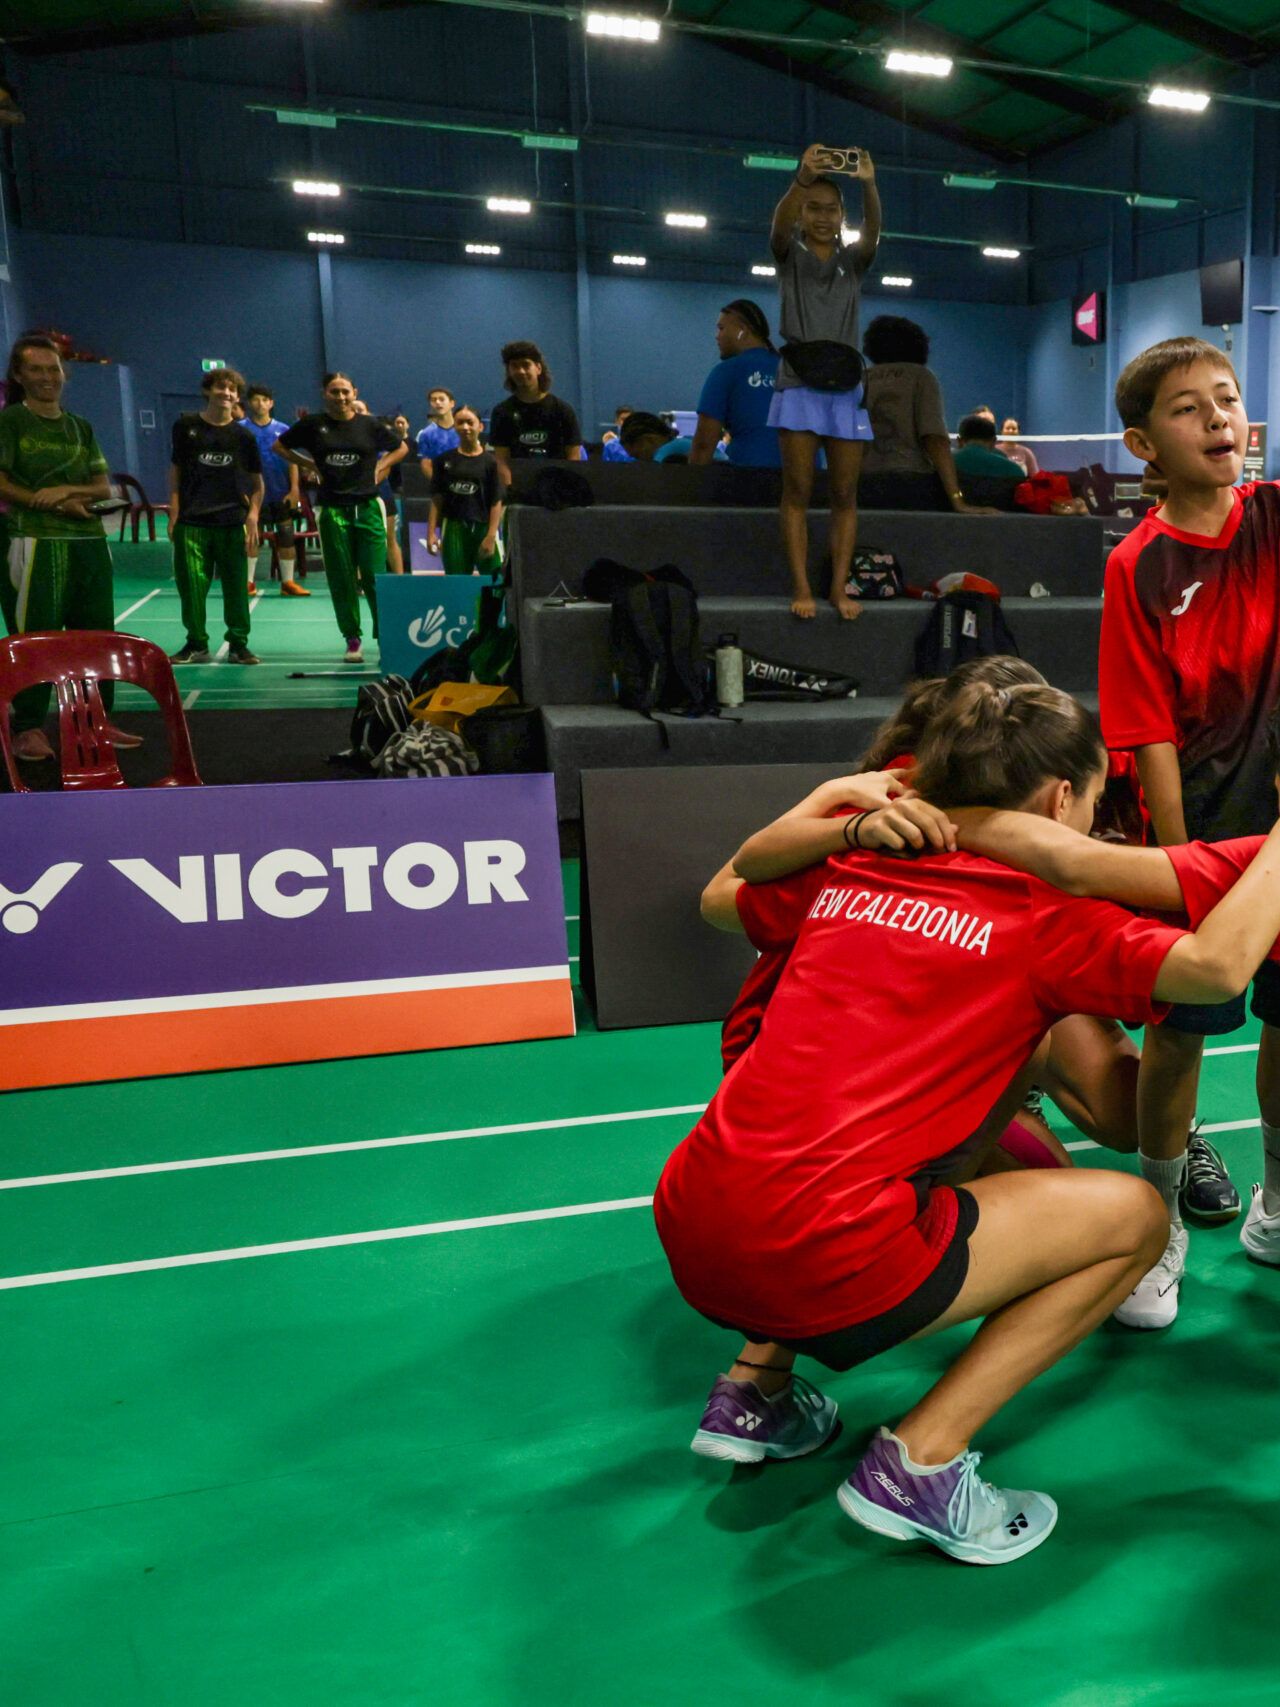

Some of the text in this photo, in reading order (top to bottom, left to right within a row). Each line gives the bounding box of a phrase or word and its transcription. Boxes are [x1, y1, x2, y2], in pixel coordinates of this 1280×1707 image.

[747, 660, 797, 686] YONEX
[108, 839, 530, 923] VICTOR
[806, 888, 993, 956] EW CALEDONIA
[870, 1471, 915, 1507] AERUS
